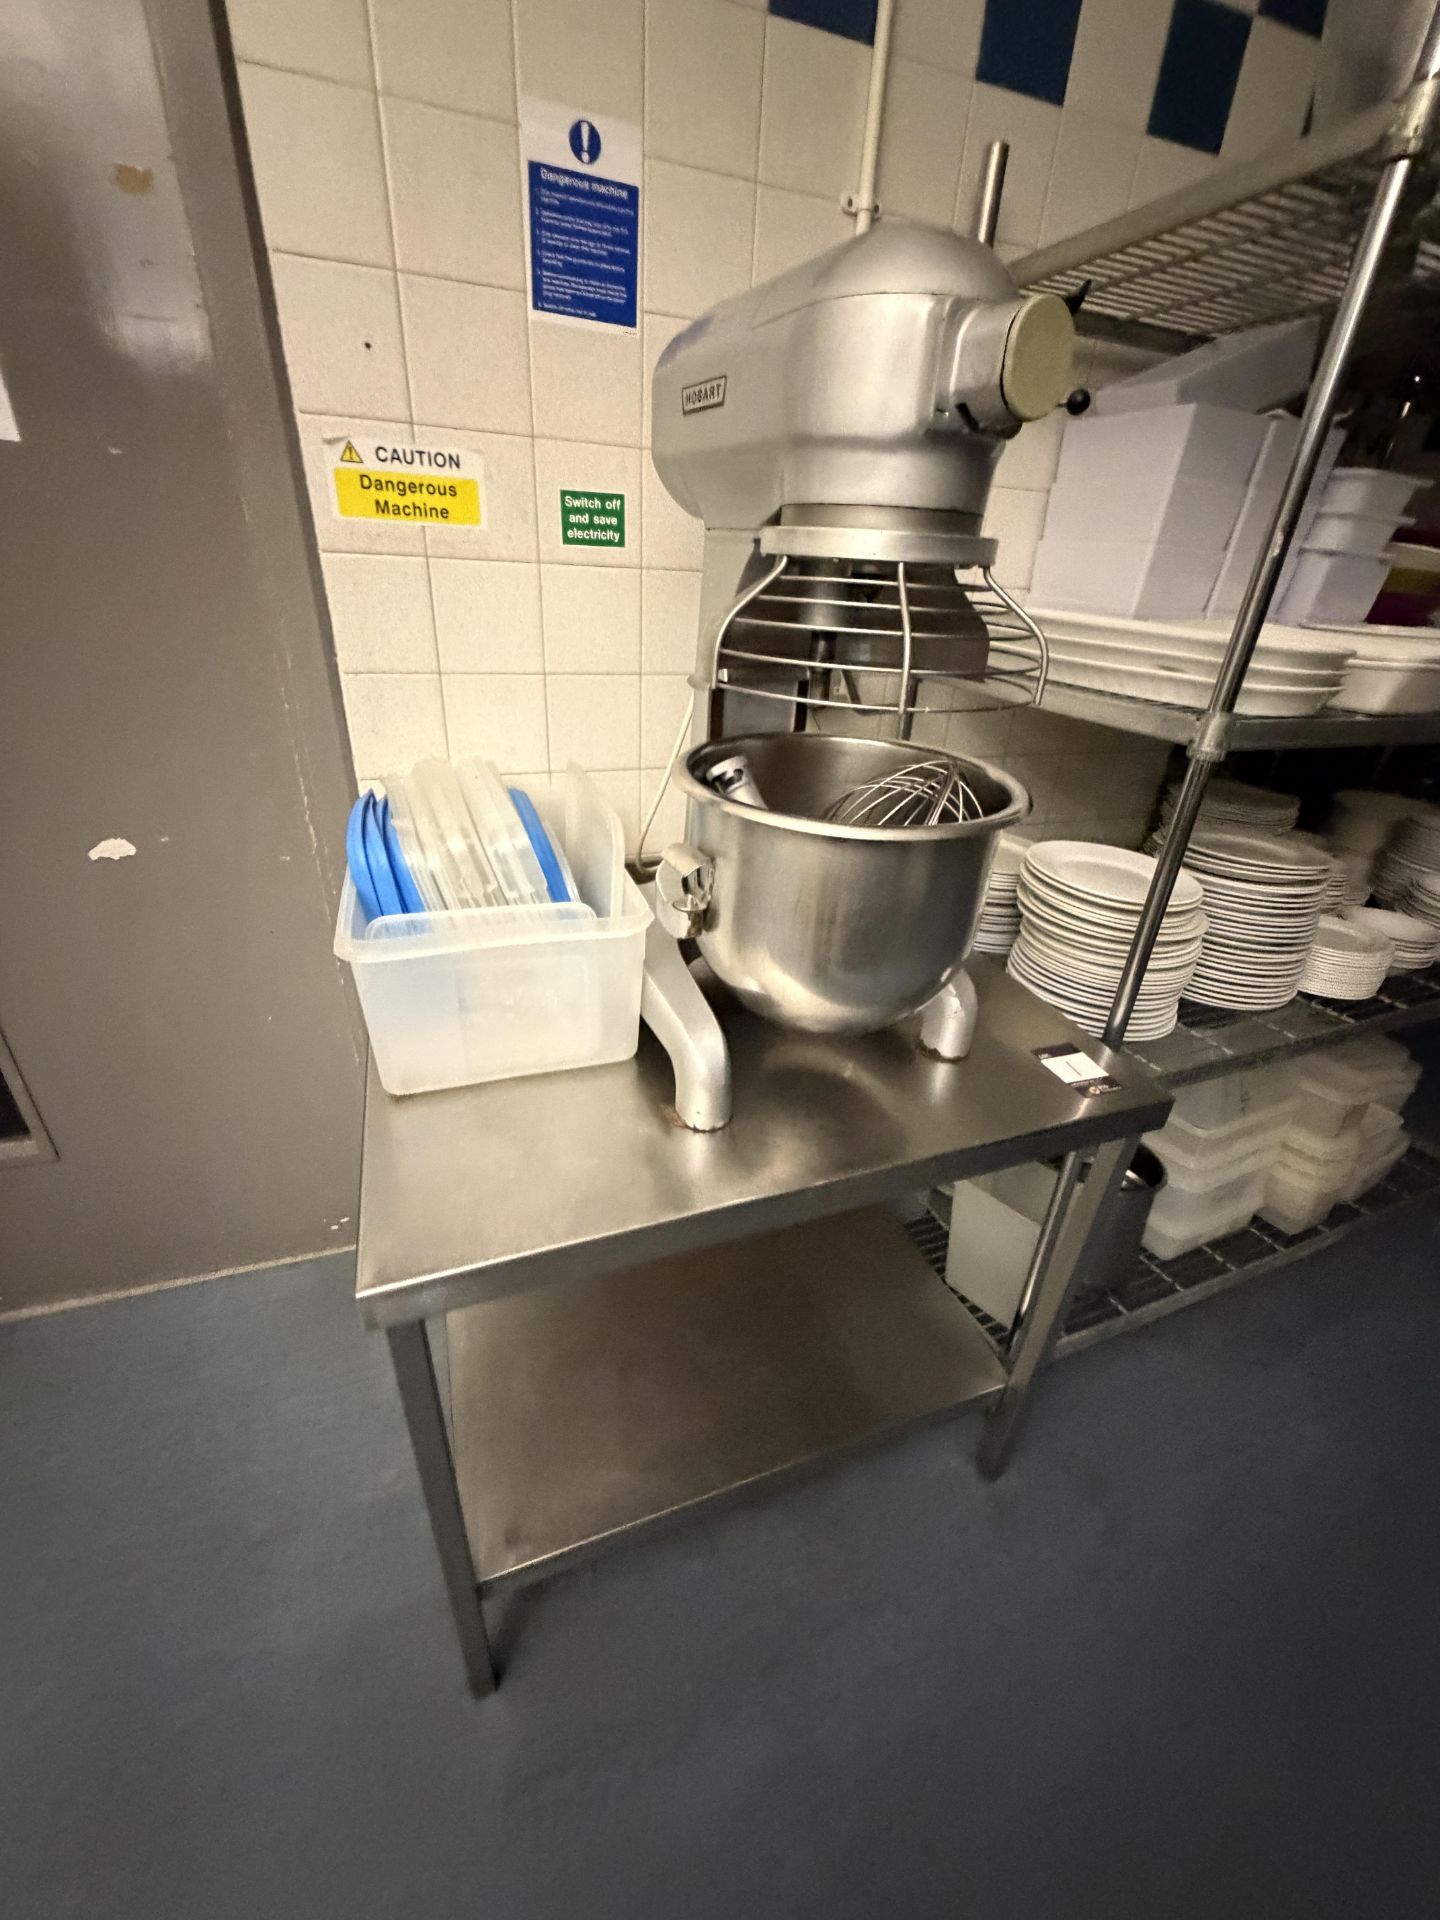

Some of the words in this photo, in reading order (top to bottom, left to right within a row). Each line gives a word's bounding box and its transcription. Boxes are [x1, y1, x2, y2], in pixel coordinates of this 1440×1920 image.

[541, 168, 590, 190] Dangerous
[591, 183, 628, 200] machine
[685, 383, 722, 407] HOBART
[375, 446, 461, 470] CAUTION
[359, 474, 458, 497] Dangerous
[374, 499, 450, 520] Machine
[564, 495, 602, 509] Switch
[605, 498, 621, 511] off
[569, 513, 590, 524] and
[593, 515, 618, 527] save
[566, 527, 620, 543] electricity
